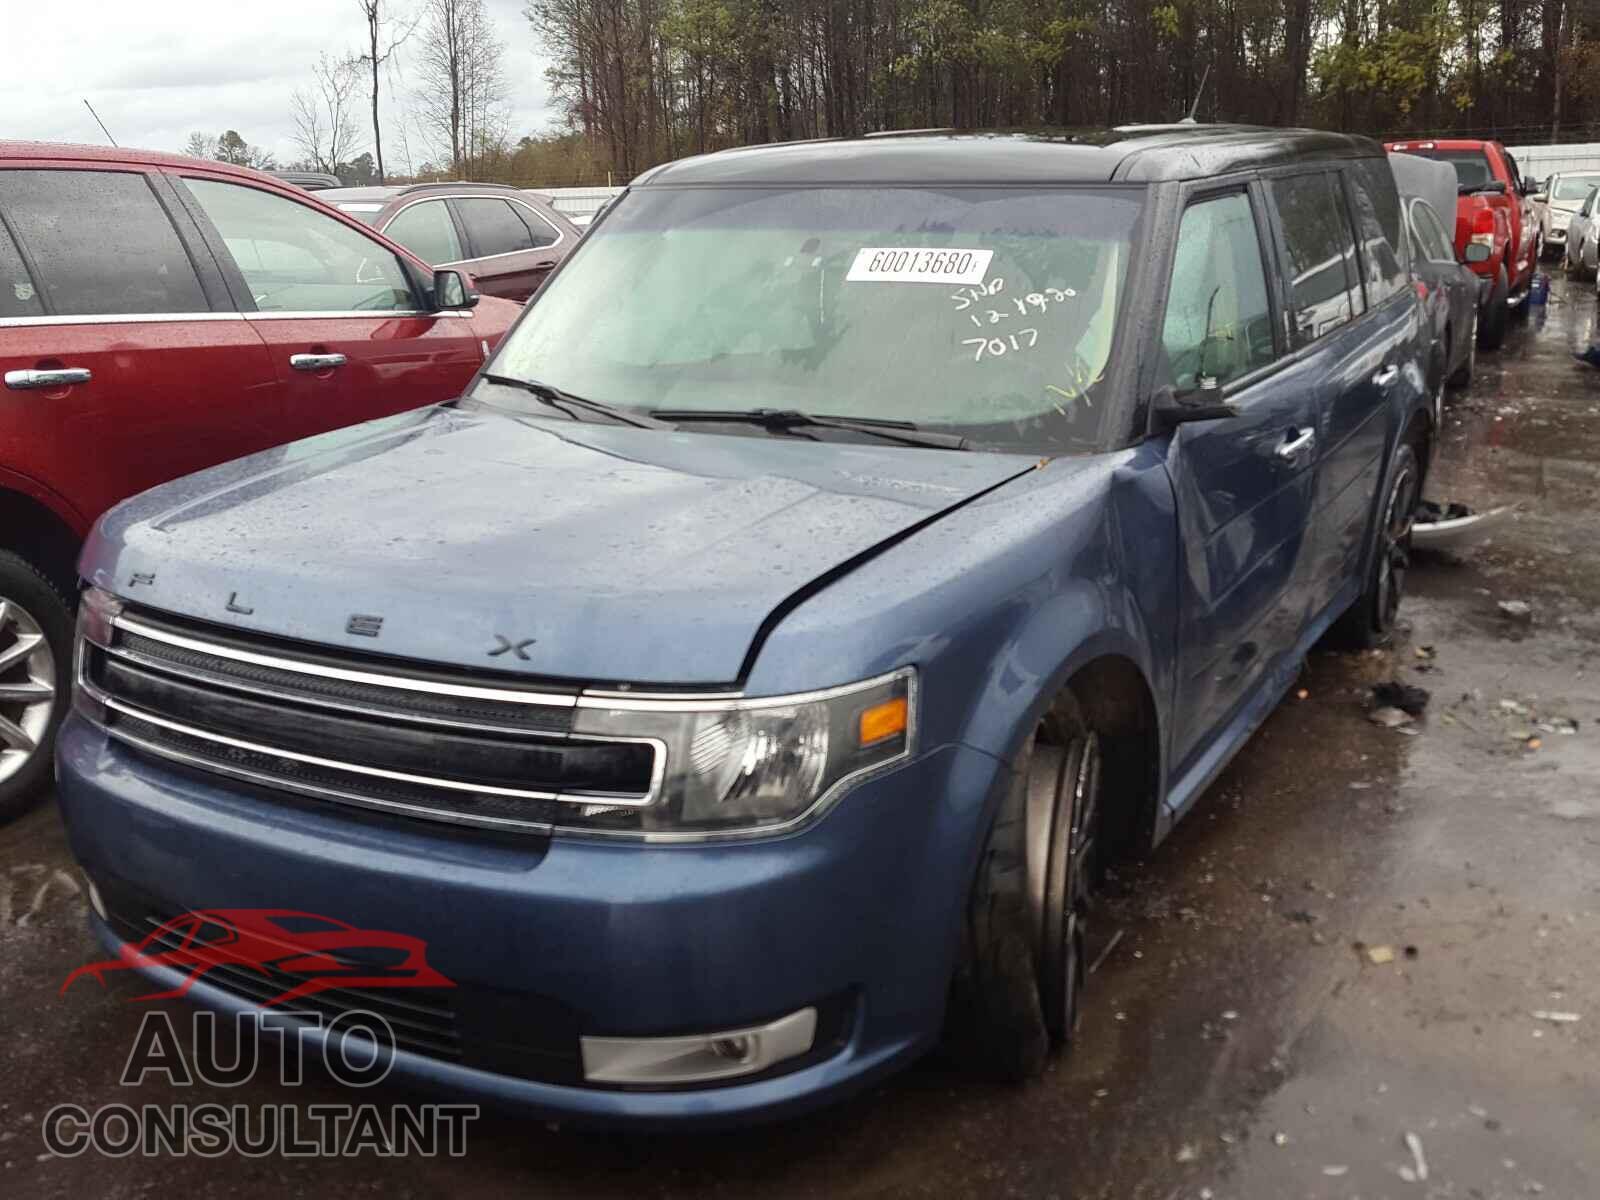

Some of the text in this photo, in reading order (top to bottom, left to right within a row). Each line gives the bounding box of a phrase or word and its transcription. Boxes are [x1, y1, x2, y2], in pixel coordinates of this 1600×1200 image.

[868, 250, 973, 274] 60013680
[961, 328, 1038, 361] 7017
[128, 573, 537, 661] FLEX
